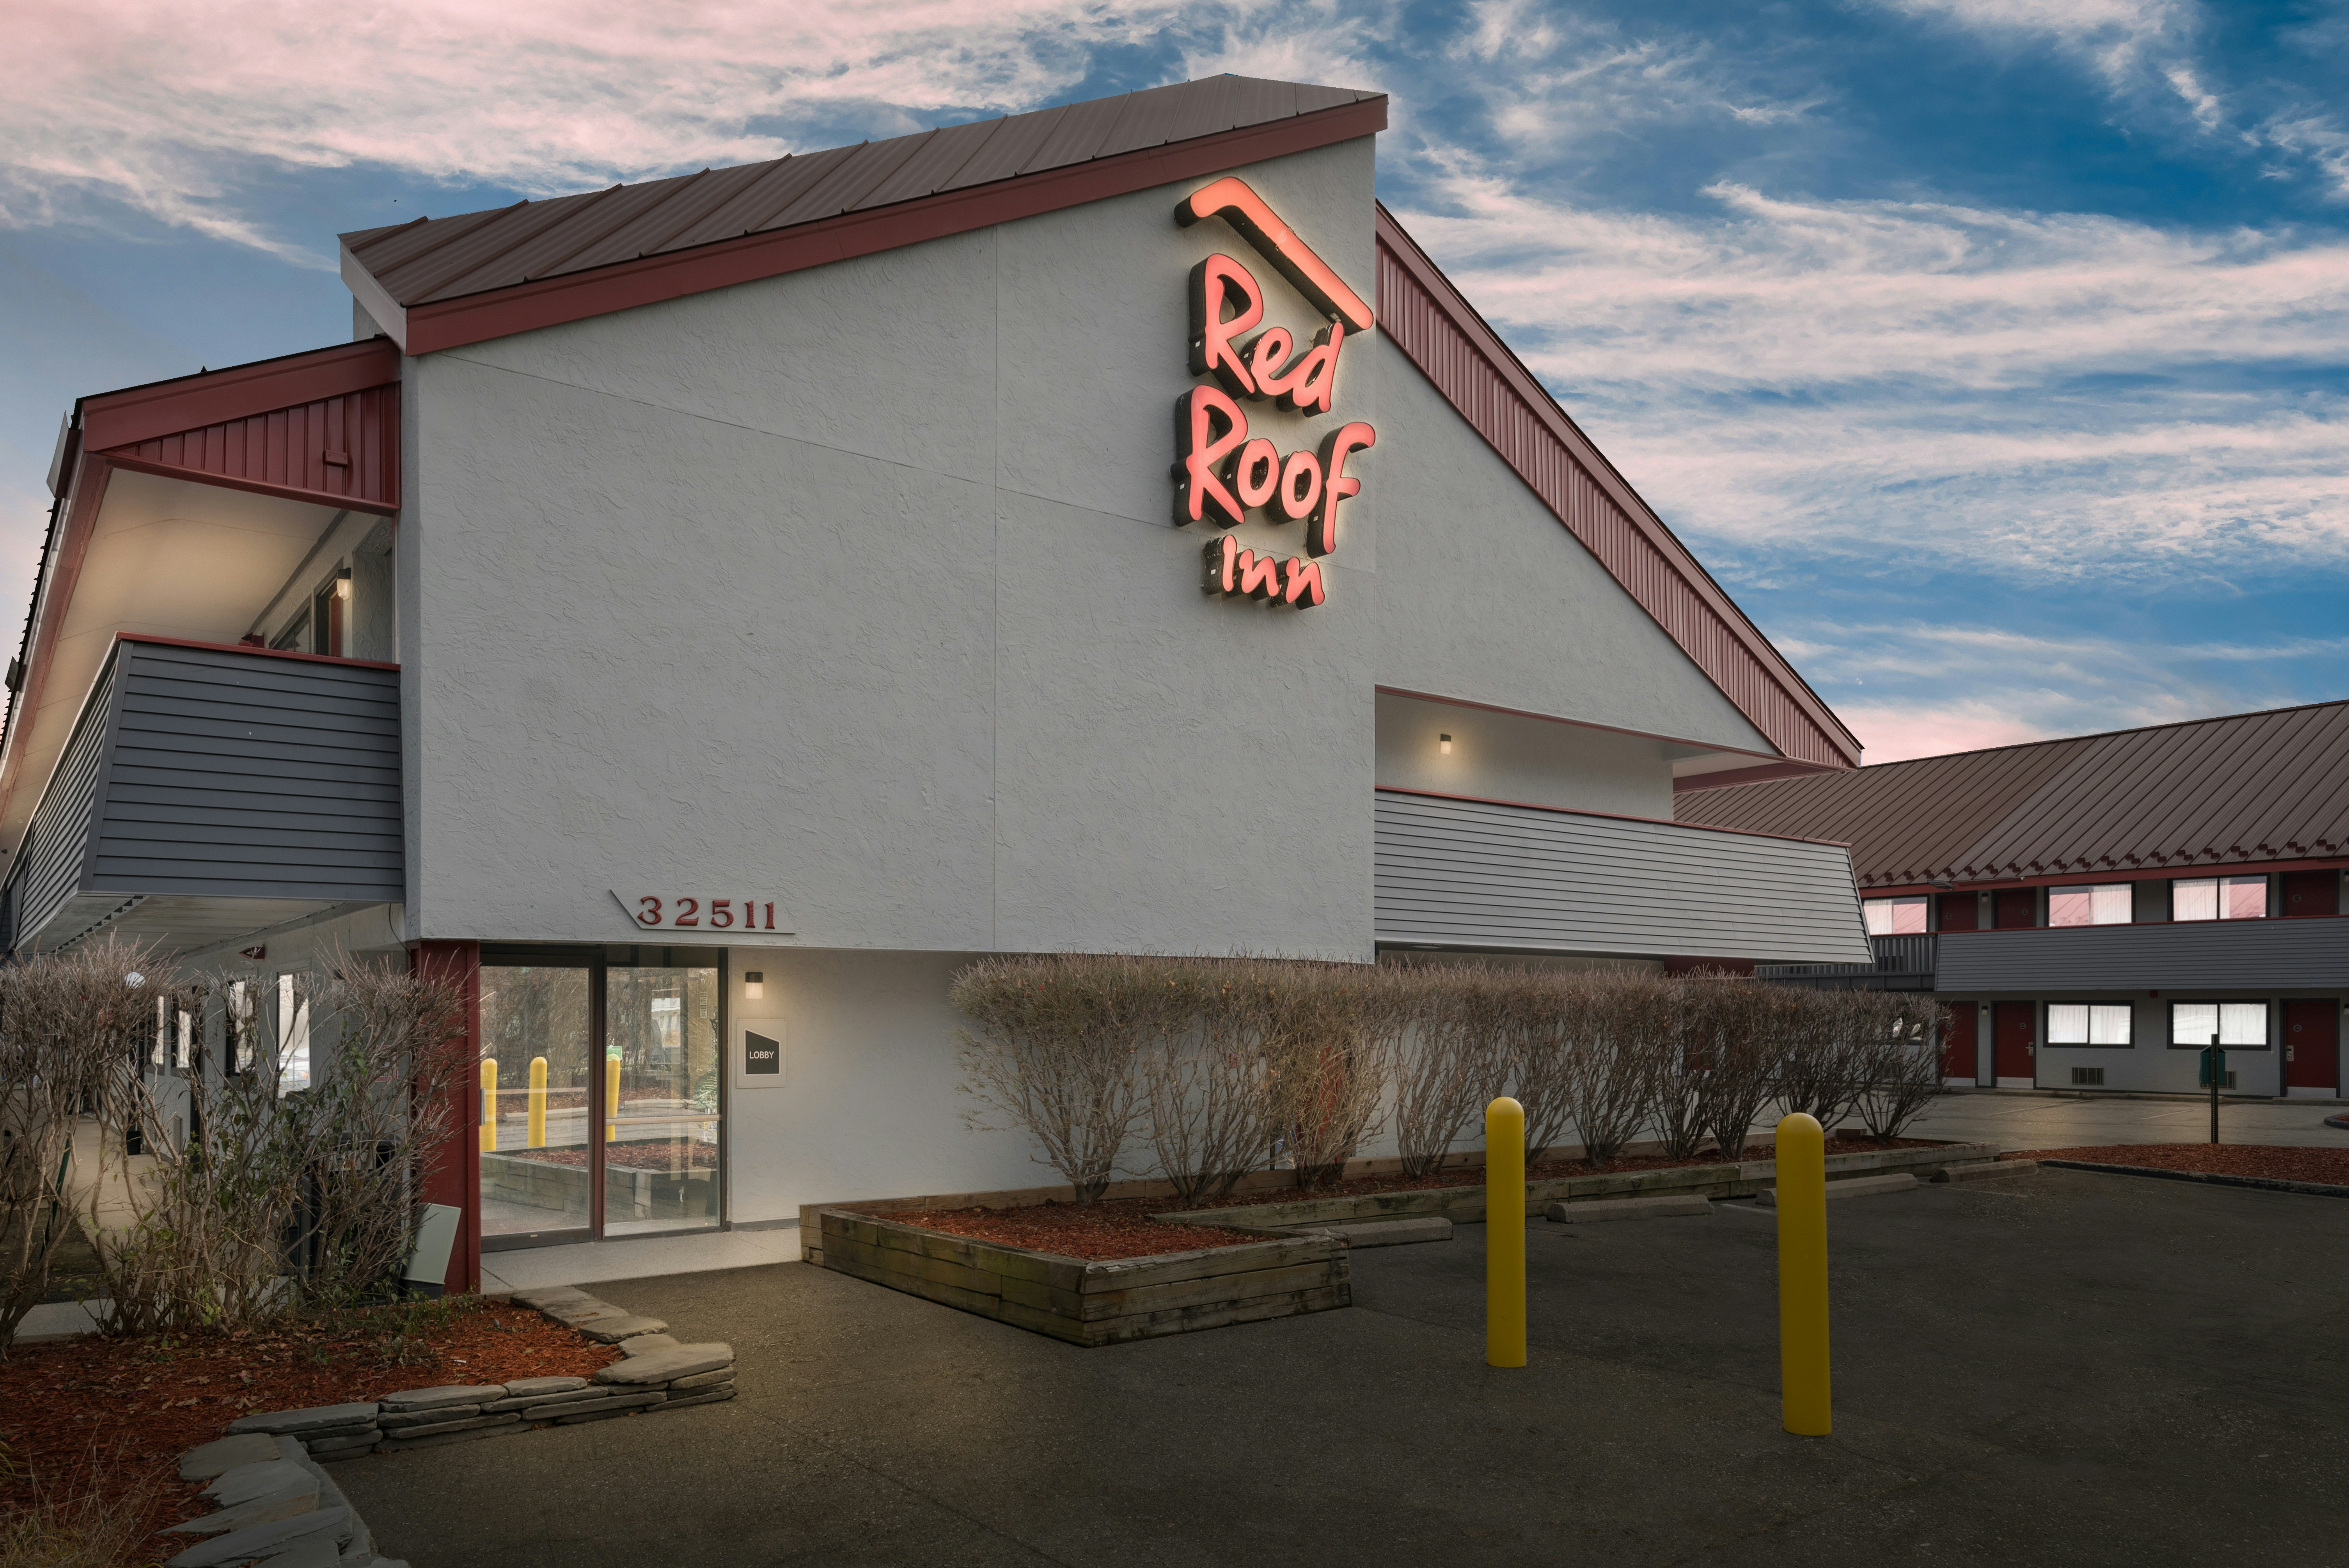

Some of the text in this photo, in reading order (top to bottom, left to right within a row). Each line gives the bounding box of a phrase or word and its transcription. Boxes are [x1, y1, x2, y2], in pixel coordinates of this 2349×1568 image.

[1205, 254, 1345, 412] Red
[1188, 385, 1375, 554] Roof
[1222, 534, 1325, 606] Inn
[637, 896, 775, 929] 32511
[749, 1051, 774, 1059] LOBBY
